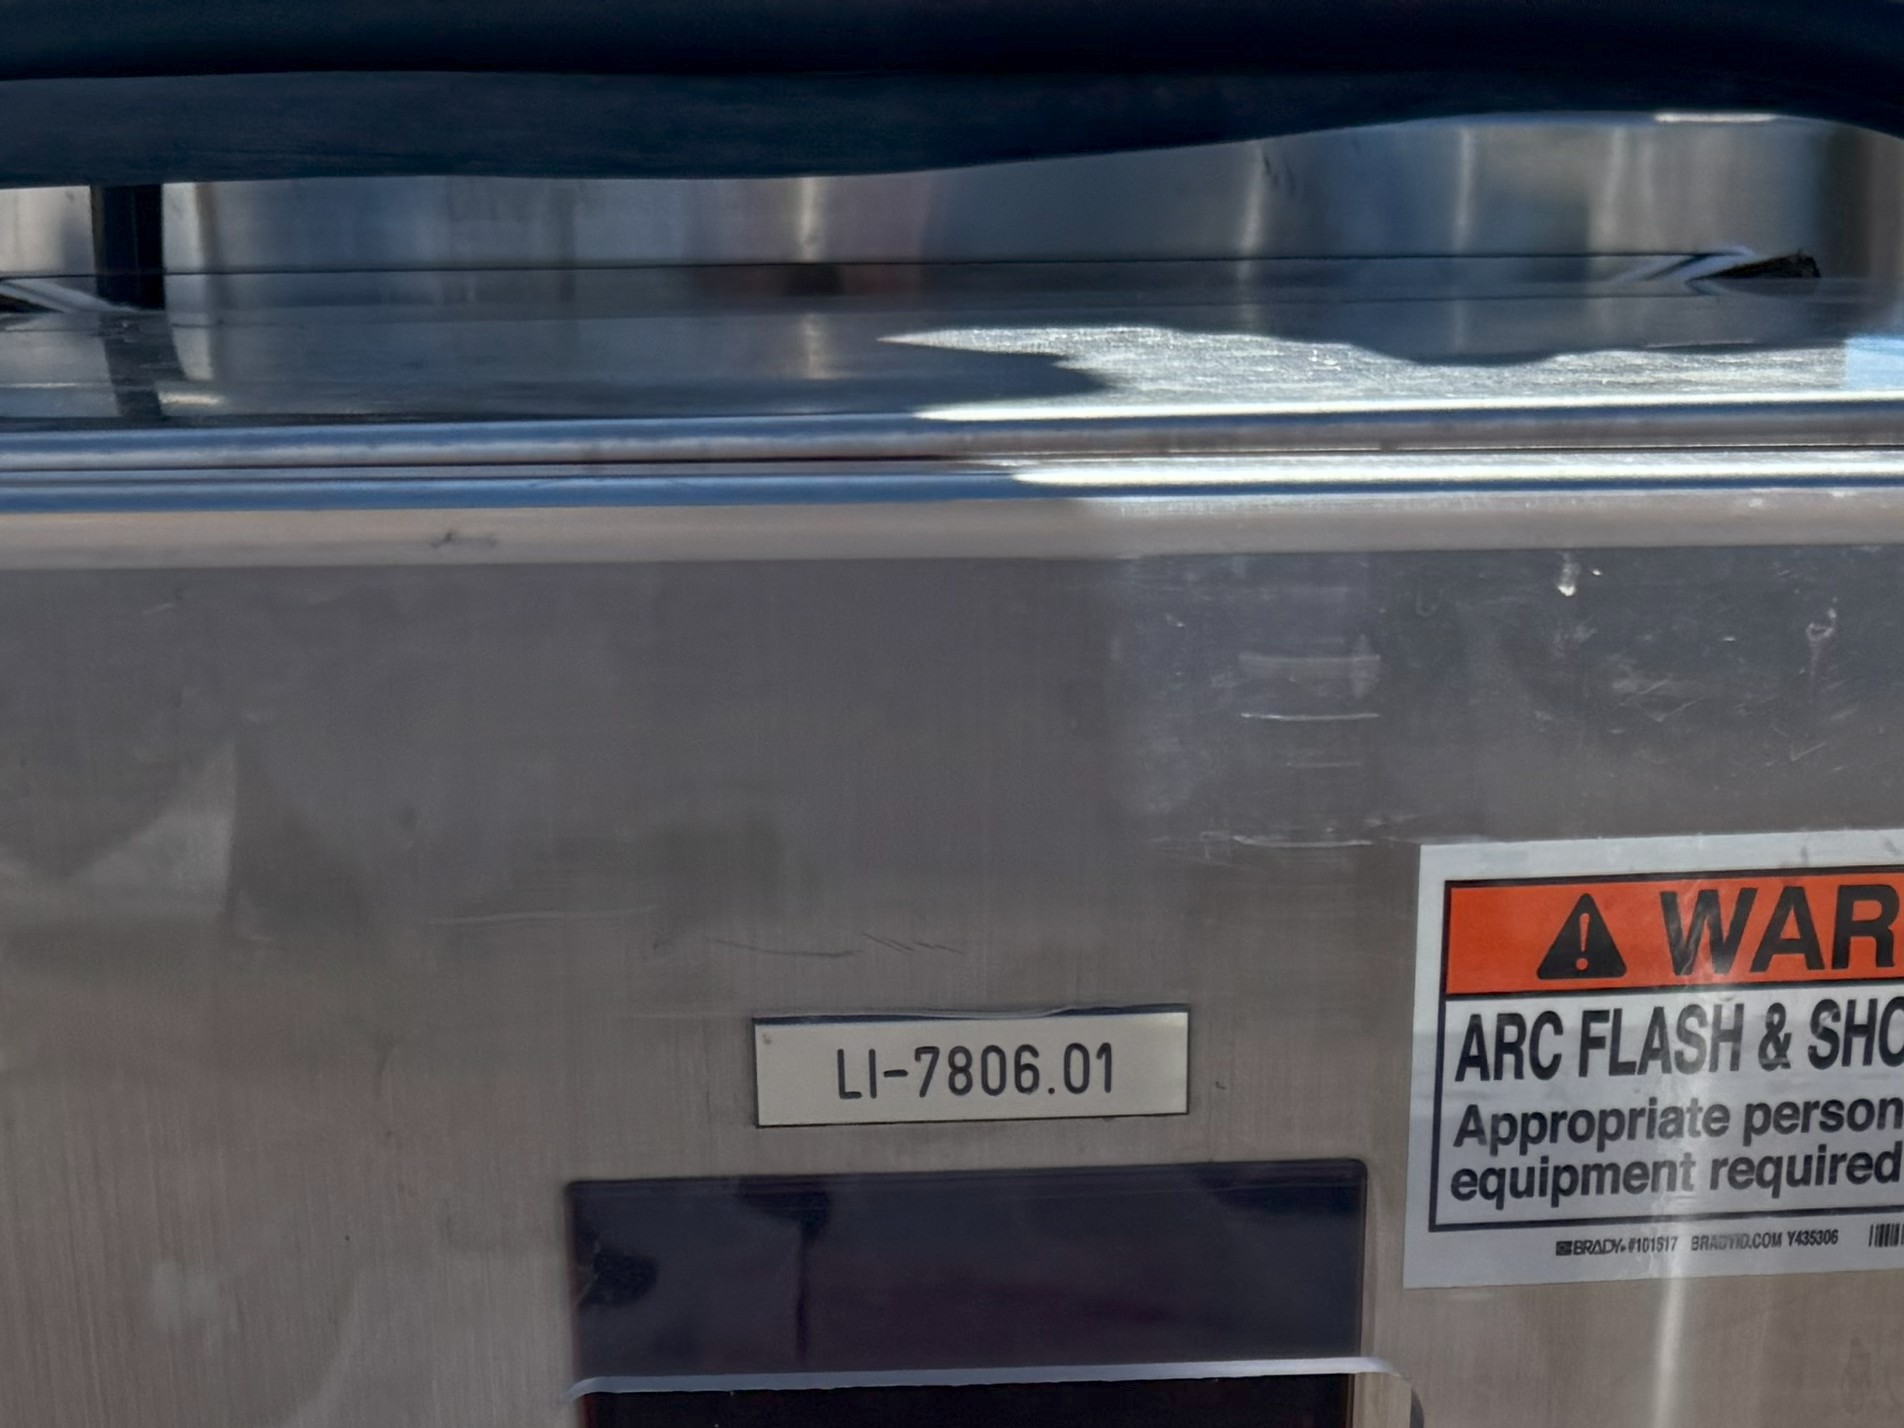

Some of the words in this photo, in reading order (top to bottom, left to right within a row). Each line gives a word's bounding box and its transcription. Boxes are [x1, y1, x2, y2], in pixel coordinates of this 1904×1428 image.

[837, 1042, 1113, 1099] LI-7806.01
[1454, 1010, 1563, 1083] ARC
[1578, 1002, 1743, 1078] FLASH
[1758, 1003, 1793, 1071] &
[1452, 1096, 1730, 1157] Appropriate
[1449, 1153, 1695, 1210] equipment
[1709, 1141, 1903, 1198] required
